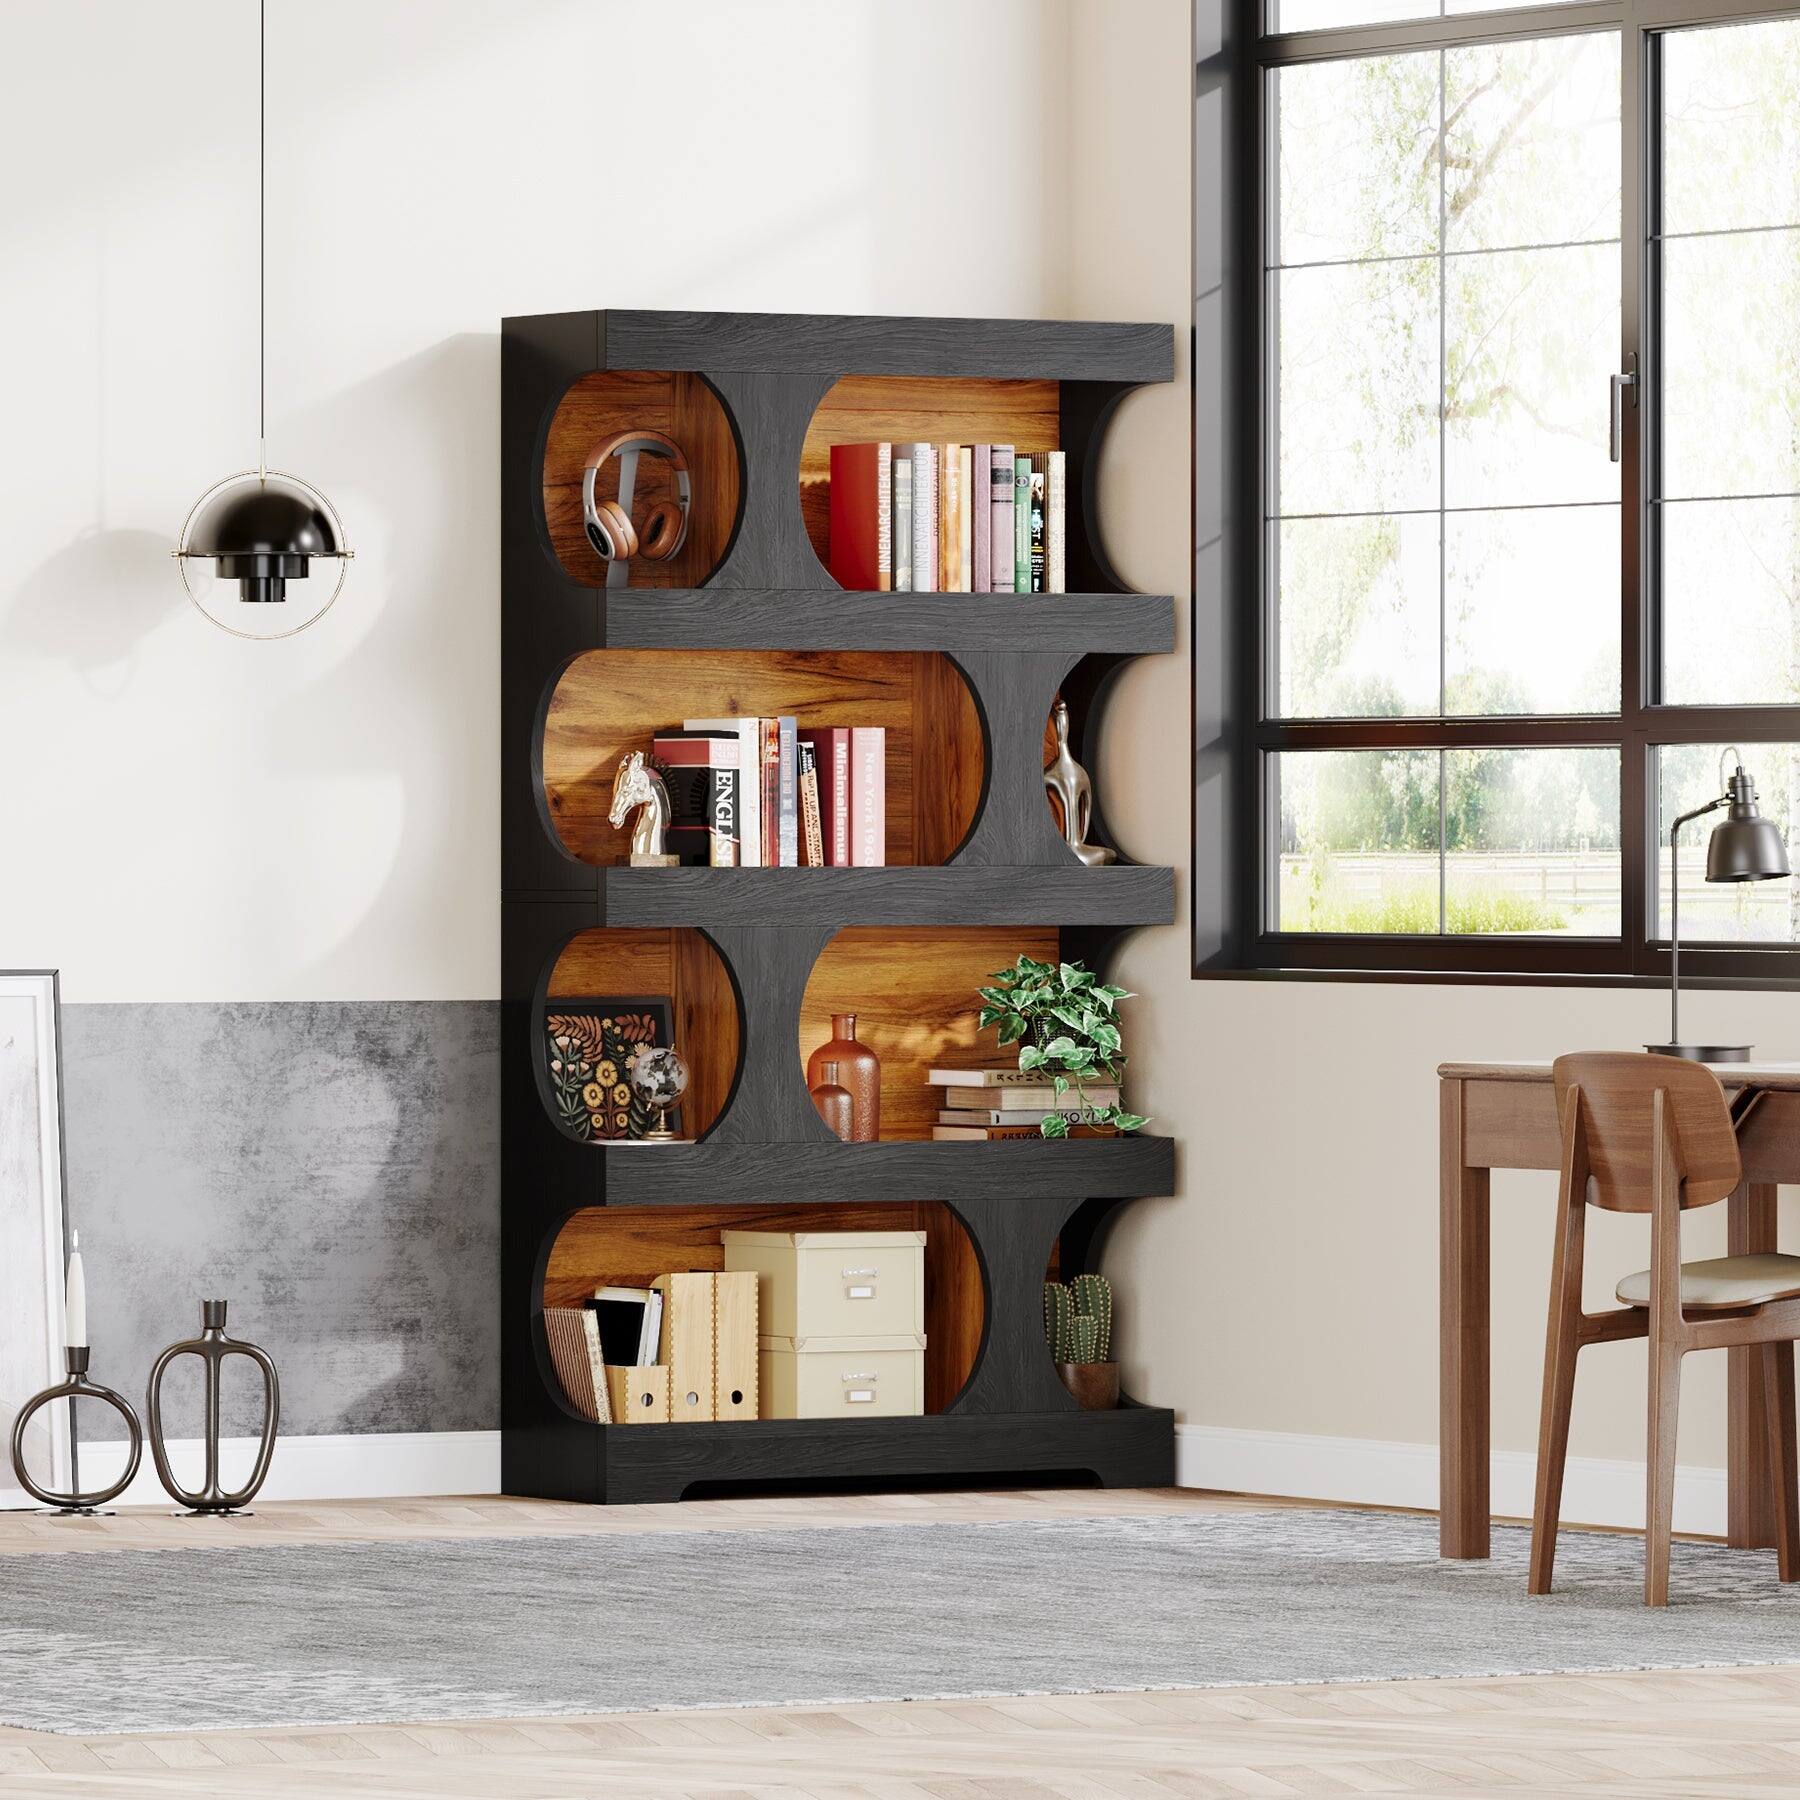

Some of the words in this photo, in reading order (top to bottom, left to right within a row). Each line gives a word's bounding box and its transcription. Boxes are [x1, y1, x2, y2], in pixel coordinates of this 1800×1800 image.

[878, 448, 891, 573] INNENARCHITEKTUR
[915, 449, 928, 573] INNENARCHITEKTUR
[837, 742, 847, 863] Minimalismus
[864, 752, 875, 784] New
[864, 787, 875, 824] York
[813, 833, 821, 859] START
